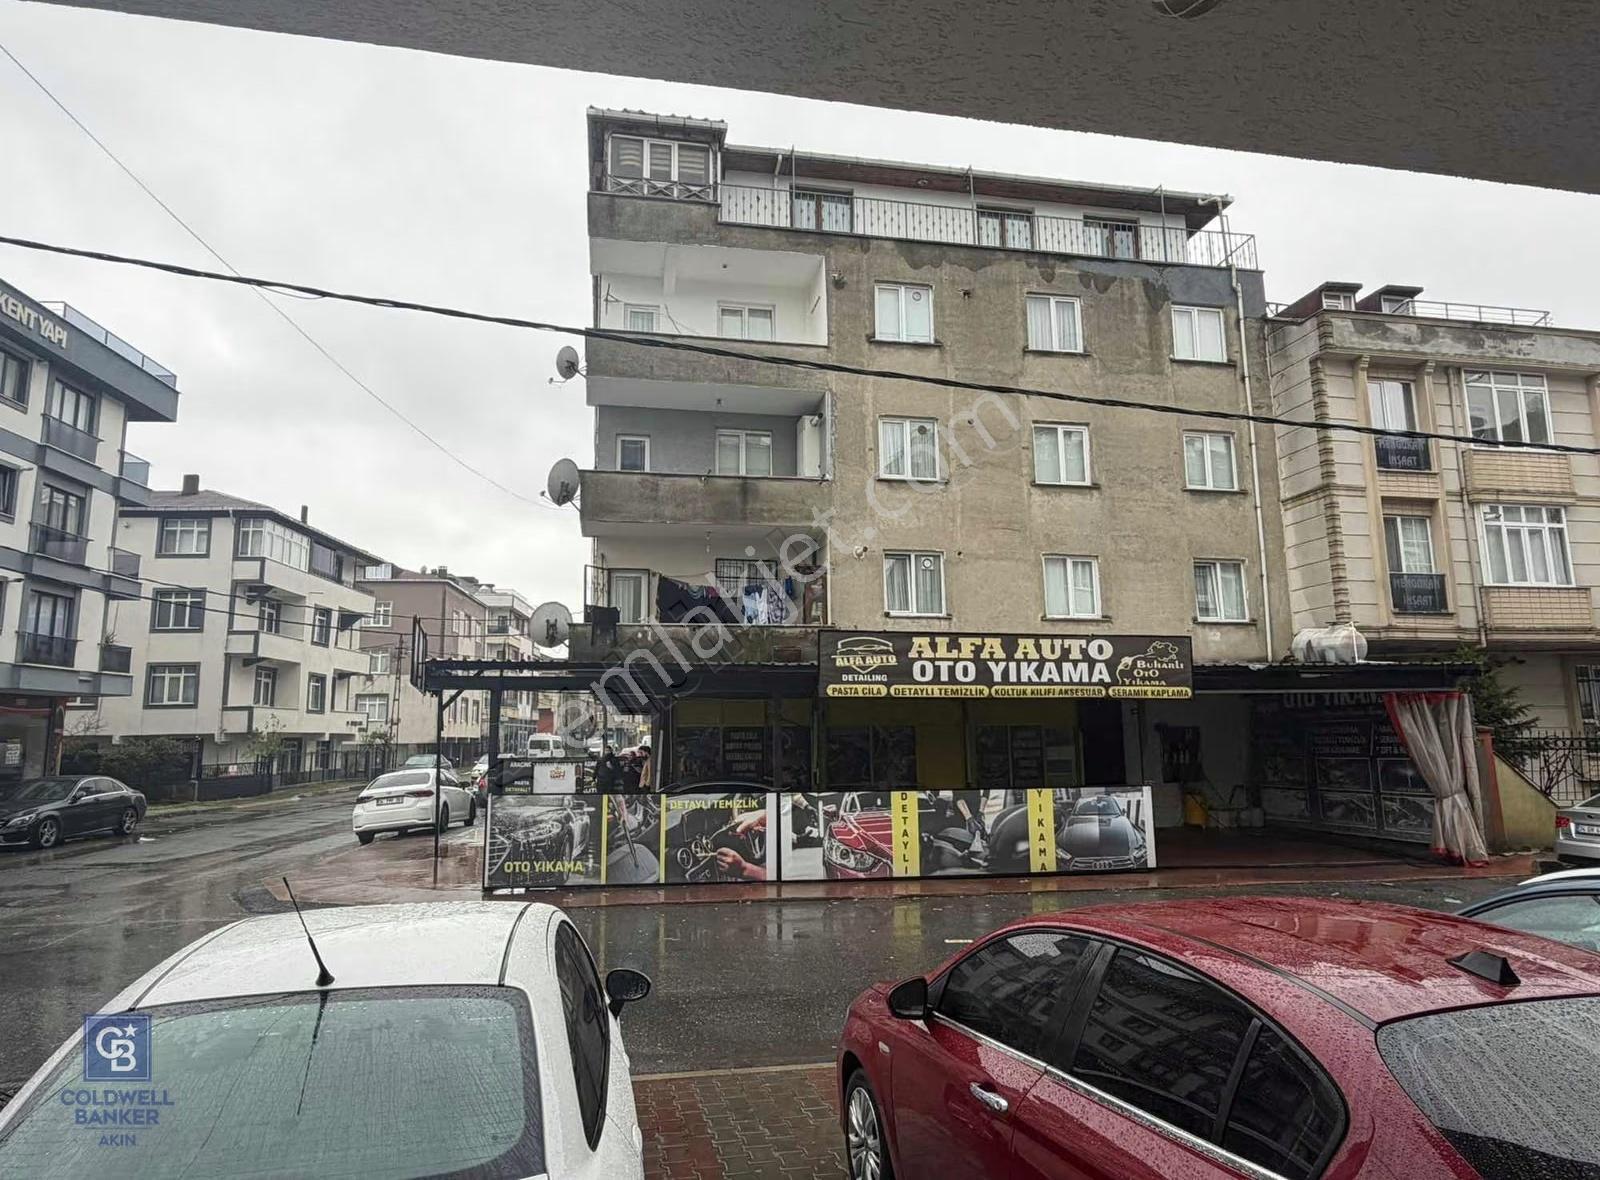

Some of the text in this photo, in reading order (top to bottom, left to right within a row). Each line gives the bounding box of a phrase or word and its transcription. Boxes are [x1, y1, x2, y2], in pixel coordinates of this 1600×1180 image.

[39, 314, 67, 349] YAPI
[908, 637, 1113, 660] ALFA AUTO
[835, 655, 896, 667] ALFA AUTO
[912, 660, 1111, 683] OTO YIKAMA
[831, 687, 859, 695] PASTA
[894, 686, 985, 696] DETAYLI TEMİZLİK
[994, 688, 1028, 696] KOLTUK
[1058, 688, 1103, 697] AKSESUAR
[1150, 688, 1189, 697] KAPLAMA
[669, 799, 710, 809] DETAYLI
[901, 792, 909, 875] DETAYLI
[1036, 789, 1047, 871] YIKAMA
[504, 861, 585, 873] OTO YIKAMA
